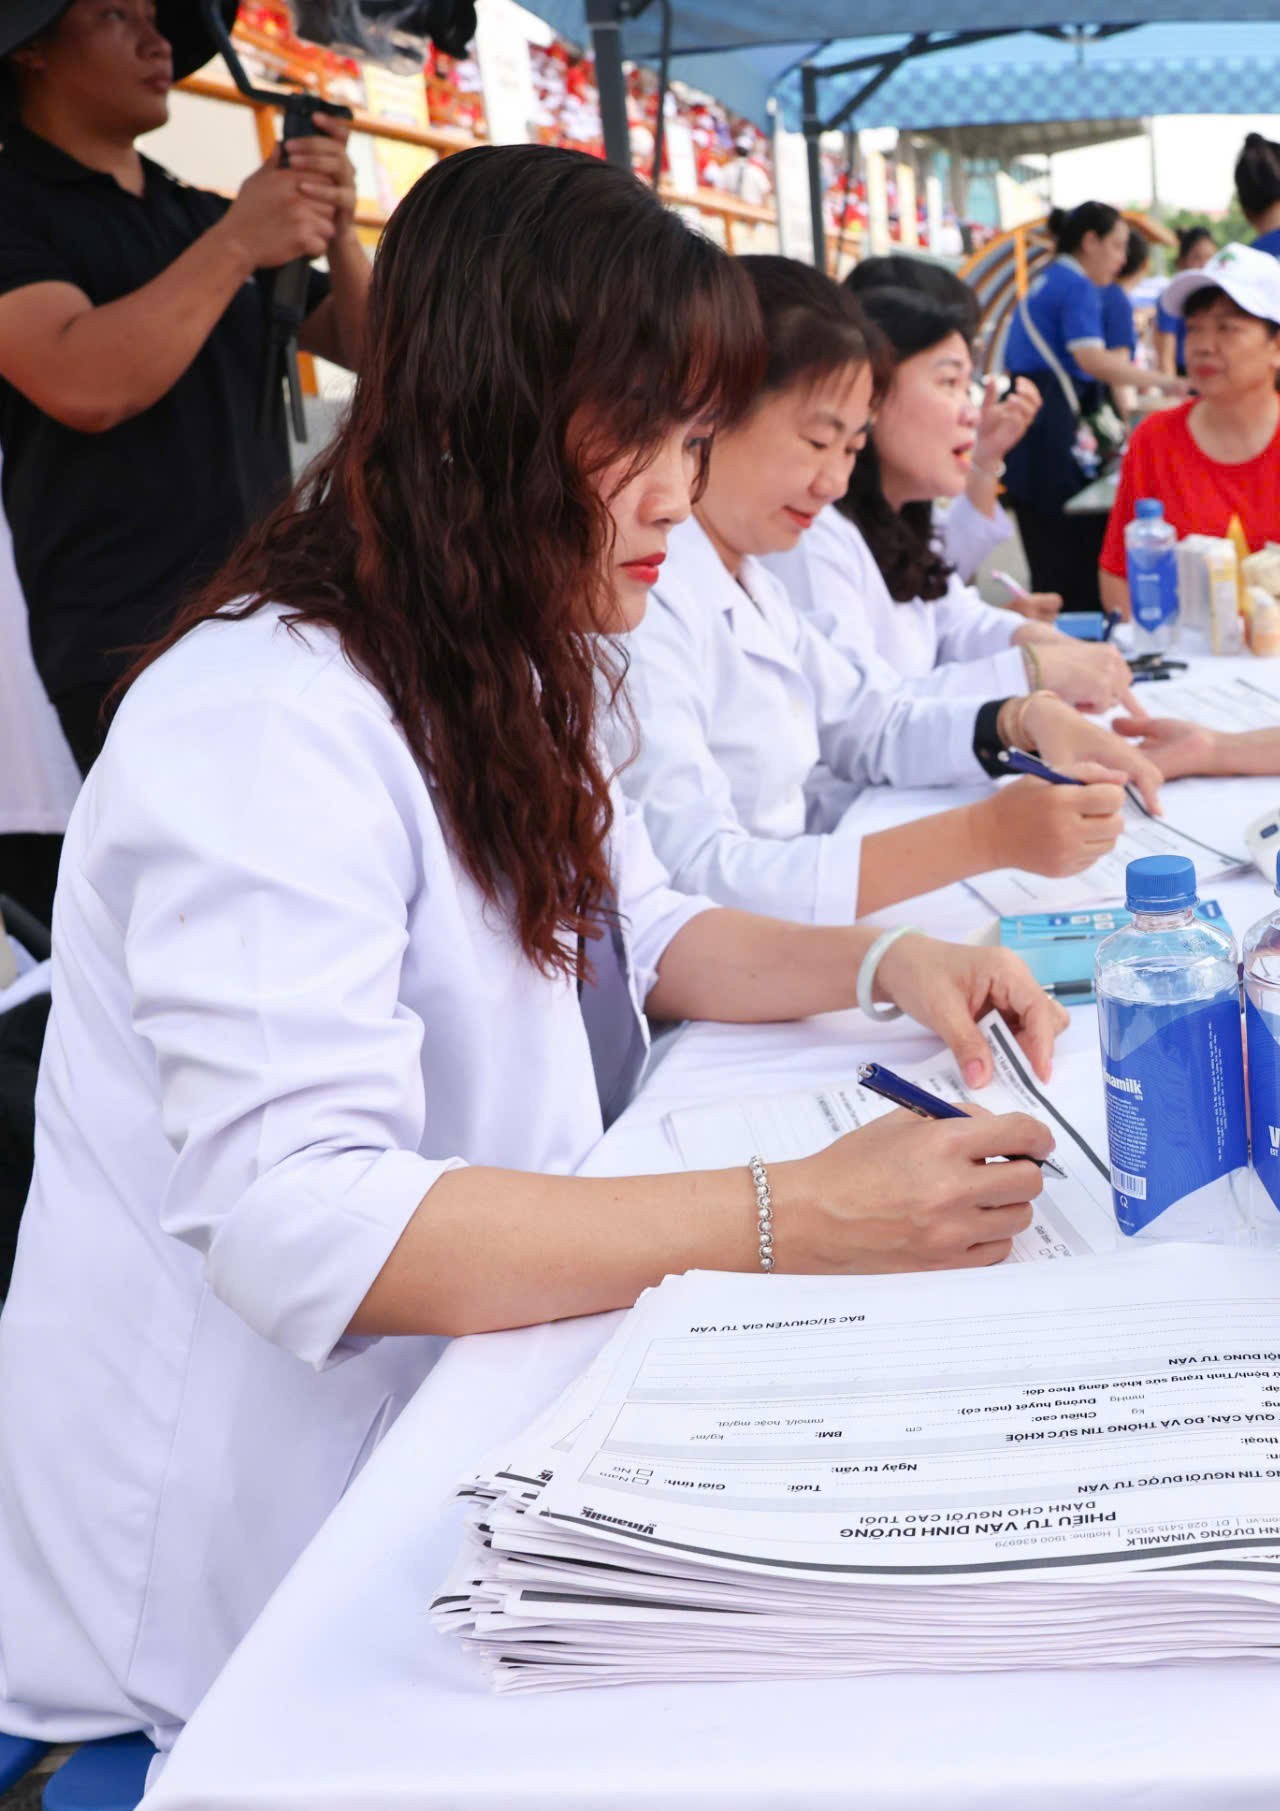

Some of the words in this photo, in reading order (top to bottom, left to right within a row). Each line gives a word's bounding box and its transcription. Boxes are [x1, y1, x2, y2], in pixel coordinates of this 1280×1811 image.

[839, 1314, 865, 1323] BÁC
[690, 1325, 716, 1333] VẤN
[719, 1324, 738, 1332] TƯ
[742, 1322, 763, 1331] GIA
[1168, 1356, 1197, 1365] VẤN
[1200, 1354, 1220, 1363] TƯ
[1223, 1352, 1260, 1361] DUNG
[1145, 1377, 1168, 1386] sức
[1171, 1372, 1204, 1383] trạng
[1047, 1385, 1075, 1396] theo
[1078, 1382, 1109, 1393] đang
[1261, 1384, 1280, 1393] áp:
[1054, 1397, 1097, 1410] Đường
[1109, 1393, 1145, 1403] mmHg
[982, 1403, 1012, 1414] (nếu
[1015, 1399, 1052, 1412] huyết
[1060, 1411, 1097, 1421] Chiều
[1131, 1407, 1145, 1416] kg
[714, 1419, 750, 1427] mg/dL
[753, 1419, 780, 1428] hoặc
[1030, 1413, 1058, 1423] cao:
[1160, 1418, 1180, 1429] VÀ
[1183, 1416, 1205, 1426] ĐO
[1207, 1414, 1241, 1425] CÂN,
[1245, 1413, 1275, 1424] QUẢ
[1080, 1426, 1104, 1436] TIN
[1106, 1420, 1157, 1434] THÔNG
[814, 1430, 843, 1439] BMI:
[1047, 1428, 1078, 1440] SỨC
[1240, 1436, 1280, 1445] thoại:
[830, 1465, 860, 1475] vấn:
[863, 1464, 879, 1473] tư
[882, 1462, 917, 1473] Ngày
[599, 1471, 629, 1482] Nam
[1137, 1473, 1182, 1487] ĐƯỢC
[1185, 1470, 1235, 1483] NGƯỜI
[1238, 1470, 1262, 1479] TIN
[663, 1478, 693, 1489] tính:
[696, 1481, 726, 1491] Giới
[787, 1483, 822, 1493] Tuổi:
[1077, 1481, 1109, 1495] VẤN
[1112, 1479, 1134, 1490] TƯ
[1007, 1506, 1044, 1517] CHO
[1048, 1500, 1096, 1514] DÀNH
[859, 1515, 899, 1526] TUỔI
[904, 1513, 941, 1524] CAO
[945, 1509, 1003, 1522] NGƯỜI
[1058, 1510, 1116, 1529] PHIẾU
[579, 1508, 655, 1535] Vinamilk
[1023, 1517, 1052, 1530] TƯ
[1185, 1520, 1209, 1529] 028
[838, 1526, 916, 1540] DƯỠNG
[921, 1524, 970, 1537] DINH
[974, 1521, 1018, 1537] VẤN
[1126, 1525, 1154, 1536] 5555
[1156, 1522, 1184, 1533] 5415
[1199, 1526, 1256, 1540] DƯỠNG
[1040, 1534, 1066, 1543] 1900
[1069, 1529, 1111, 1542] Hotline:
[1125, 1531, 1196, 1547] VINAMILK
[994, 1537, 1037, 1548] 636979
